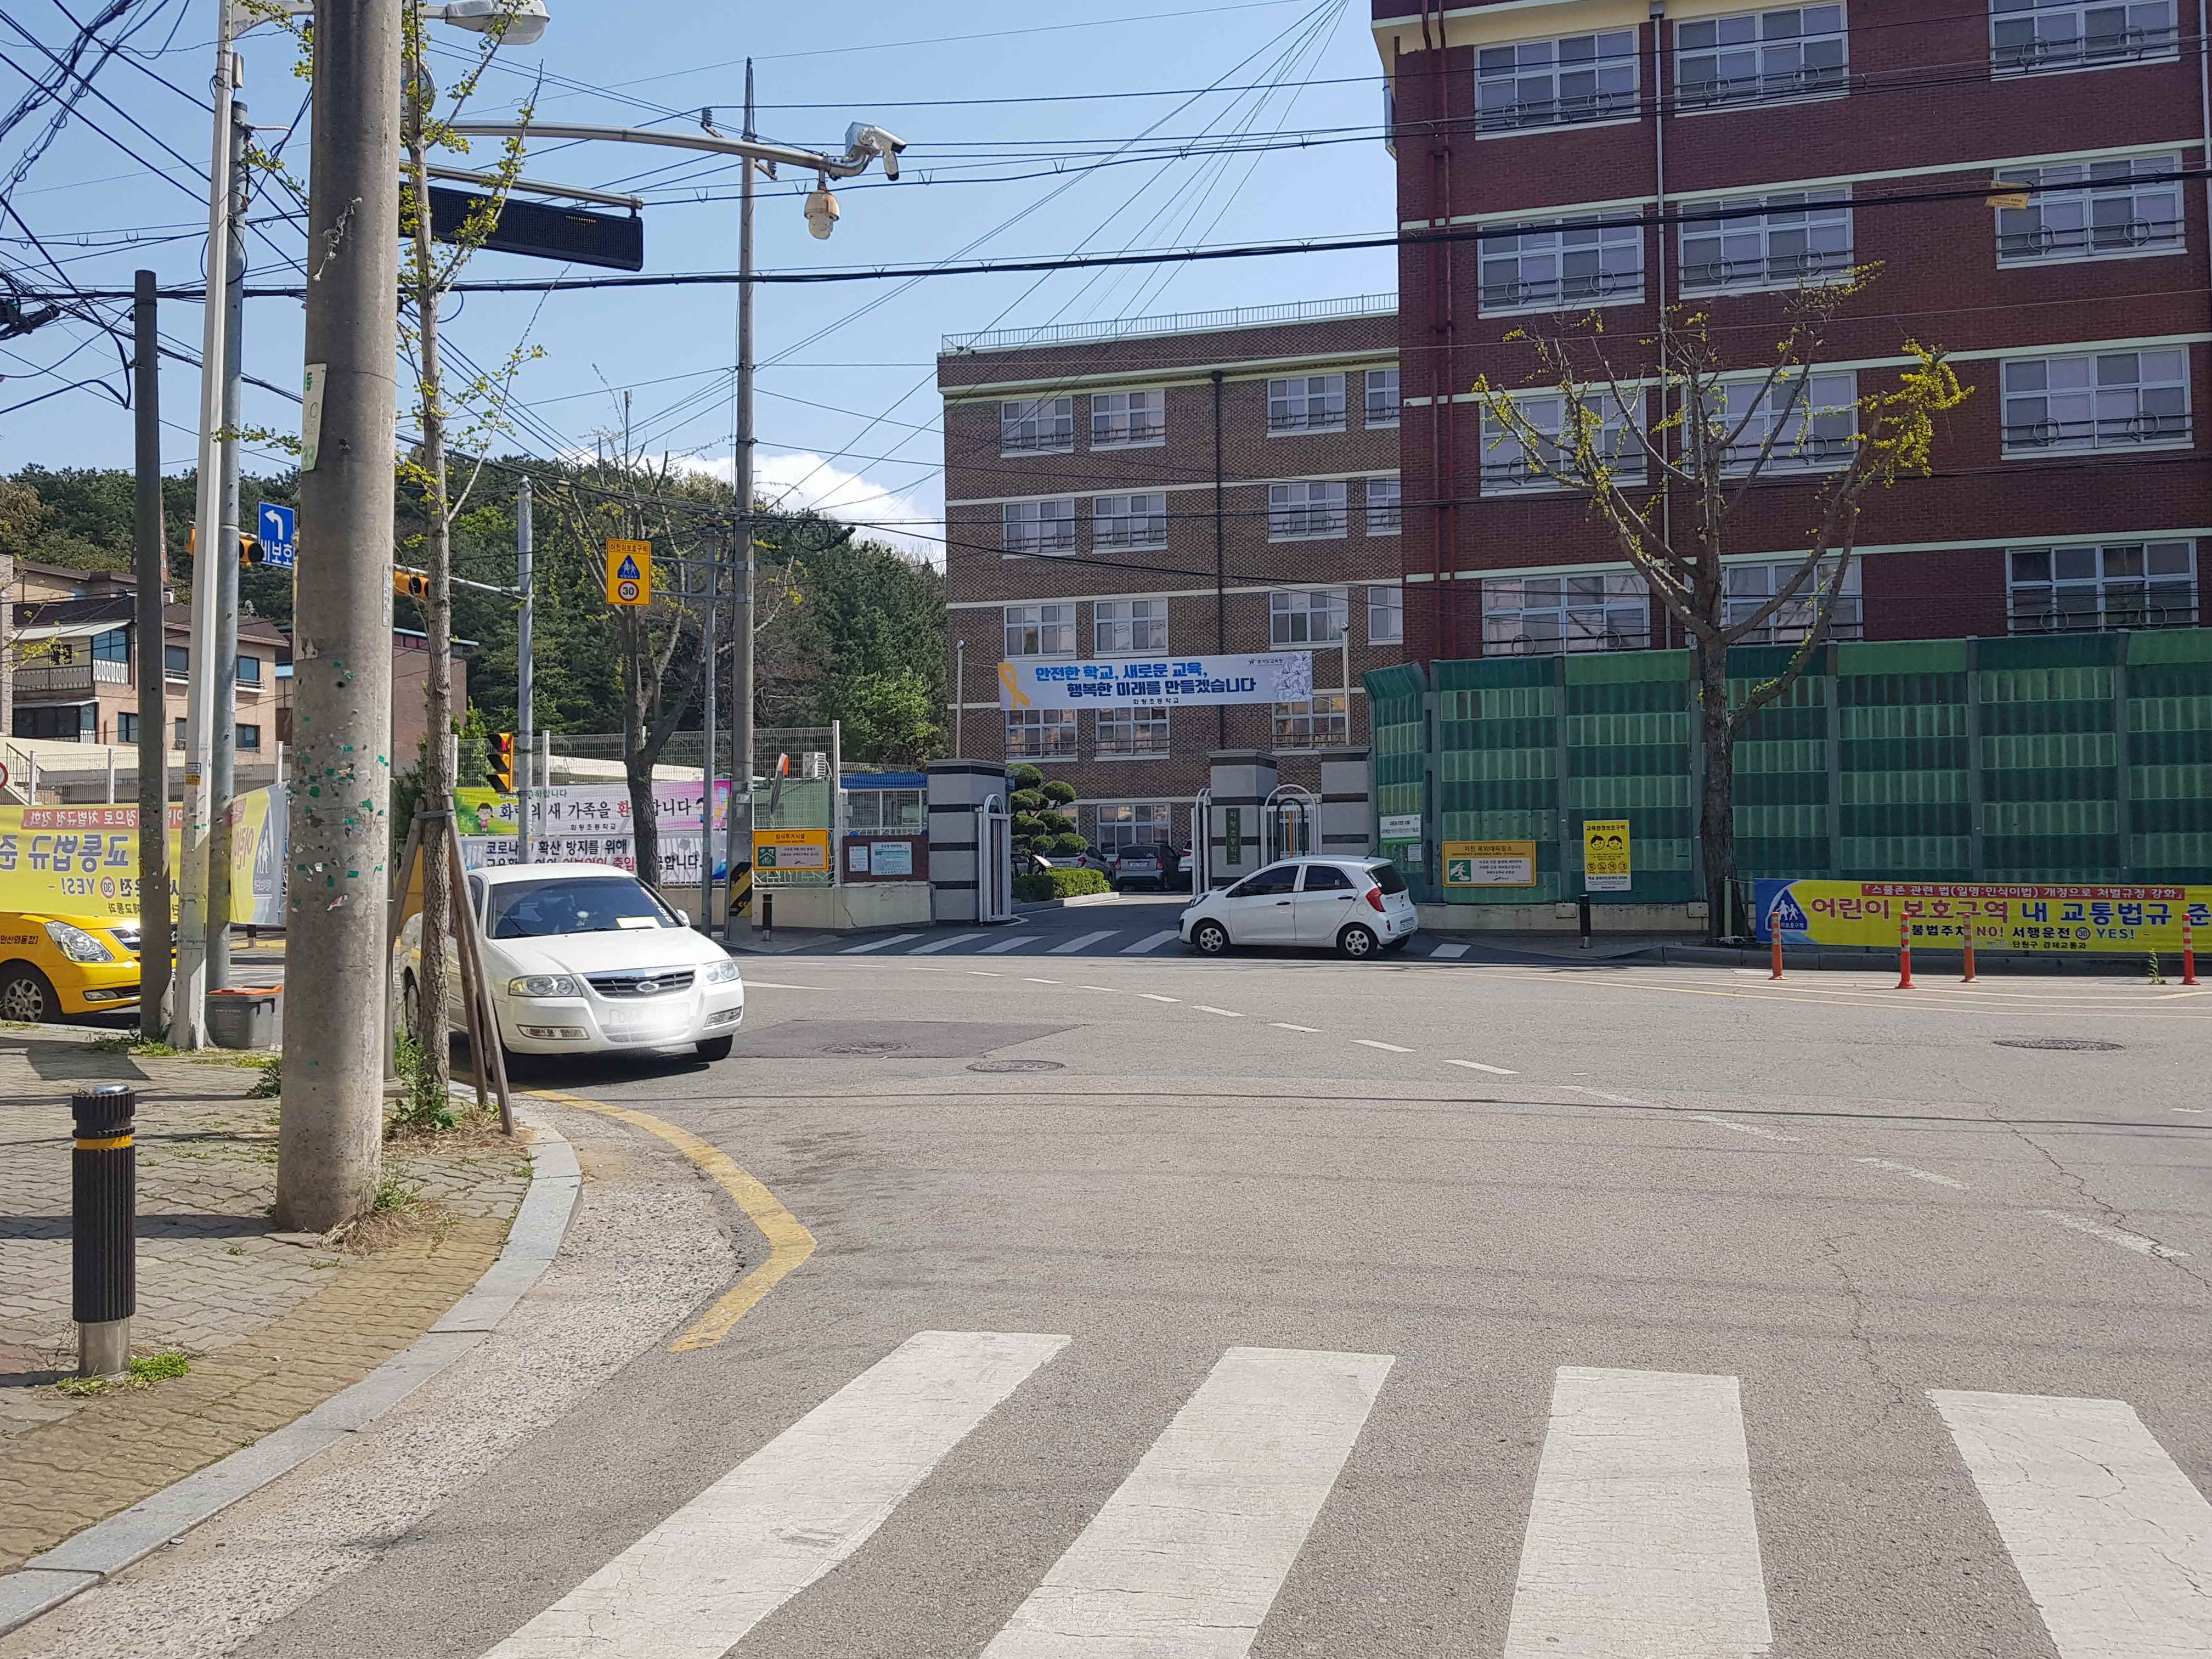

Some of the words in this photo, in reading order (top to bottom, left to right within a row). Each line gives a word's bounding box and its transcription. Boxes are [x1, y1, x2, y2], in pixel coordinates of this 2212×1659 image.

[611, 543, 647, 554] 어린이보호구역
[623, 586, 634, 596] 30
[1035, 665, 1080, 681] 안전한
[1083, 665, 1119, 681] 학교,
[1123, 663, 1168, 679] 새로운
[1172, 662, 1207, 678] 교육,
[1066, 681, 1113, 697] 행복한
[1116, 681, 1161, 696] 미래를
[1165, 677, 1257, 695] 만들겠습니다
[548, 802, 561, 820] 새
[568, 801, 611, 819] 가족을
[538, 840, 561, 856] 확산
[566, 840, 600, 855] 방지를
[605, 839, 627, 854] 위해
[1910, 885, 1934, 896] 관련
[2043, 887, 2092, 898] 개정으로
[2097, 887, 2146, 899] 처벌규정
[1810, 898, 1890, 920] 어린이
[1904, 899, 2009, 924] 보호구역
[2022, 902, 2048, 923] 내
[2059, 901, 2172, 926] 교통법규
[1977, 926, 2004, 938] NO!
[2012, 927, 2070, 939] 서행운전
[2078, 929, 2089, 938] 30
[2097, 928, 2135, 939] YES!
